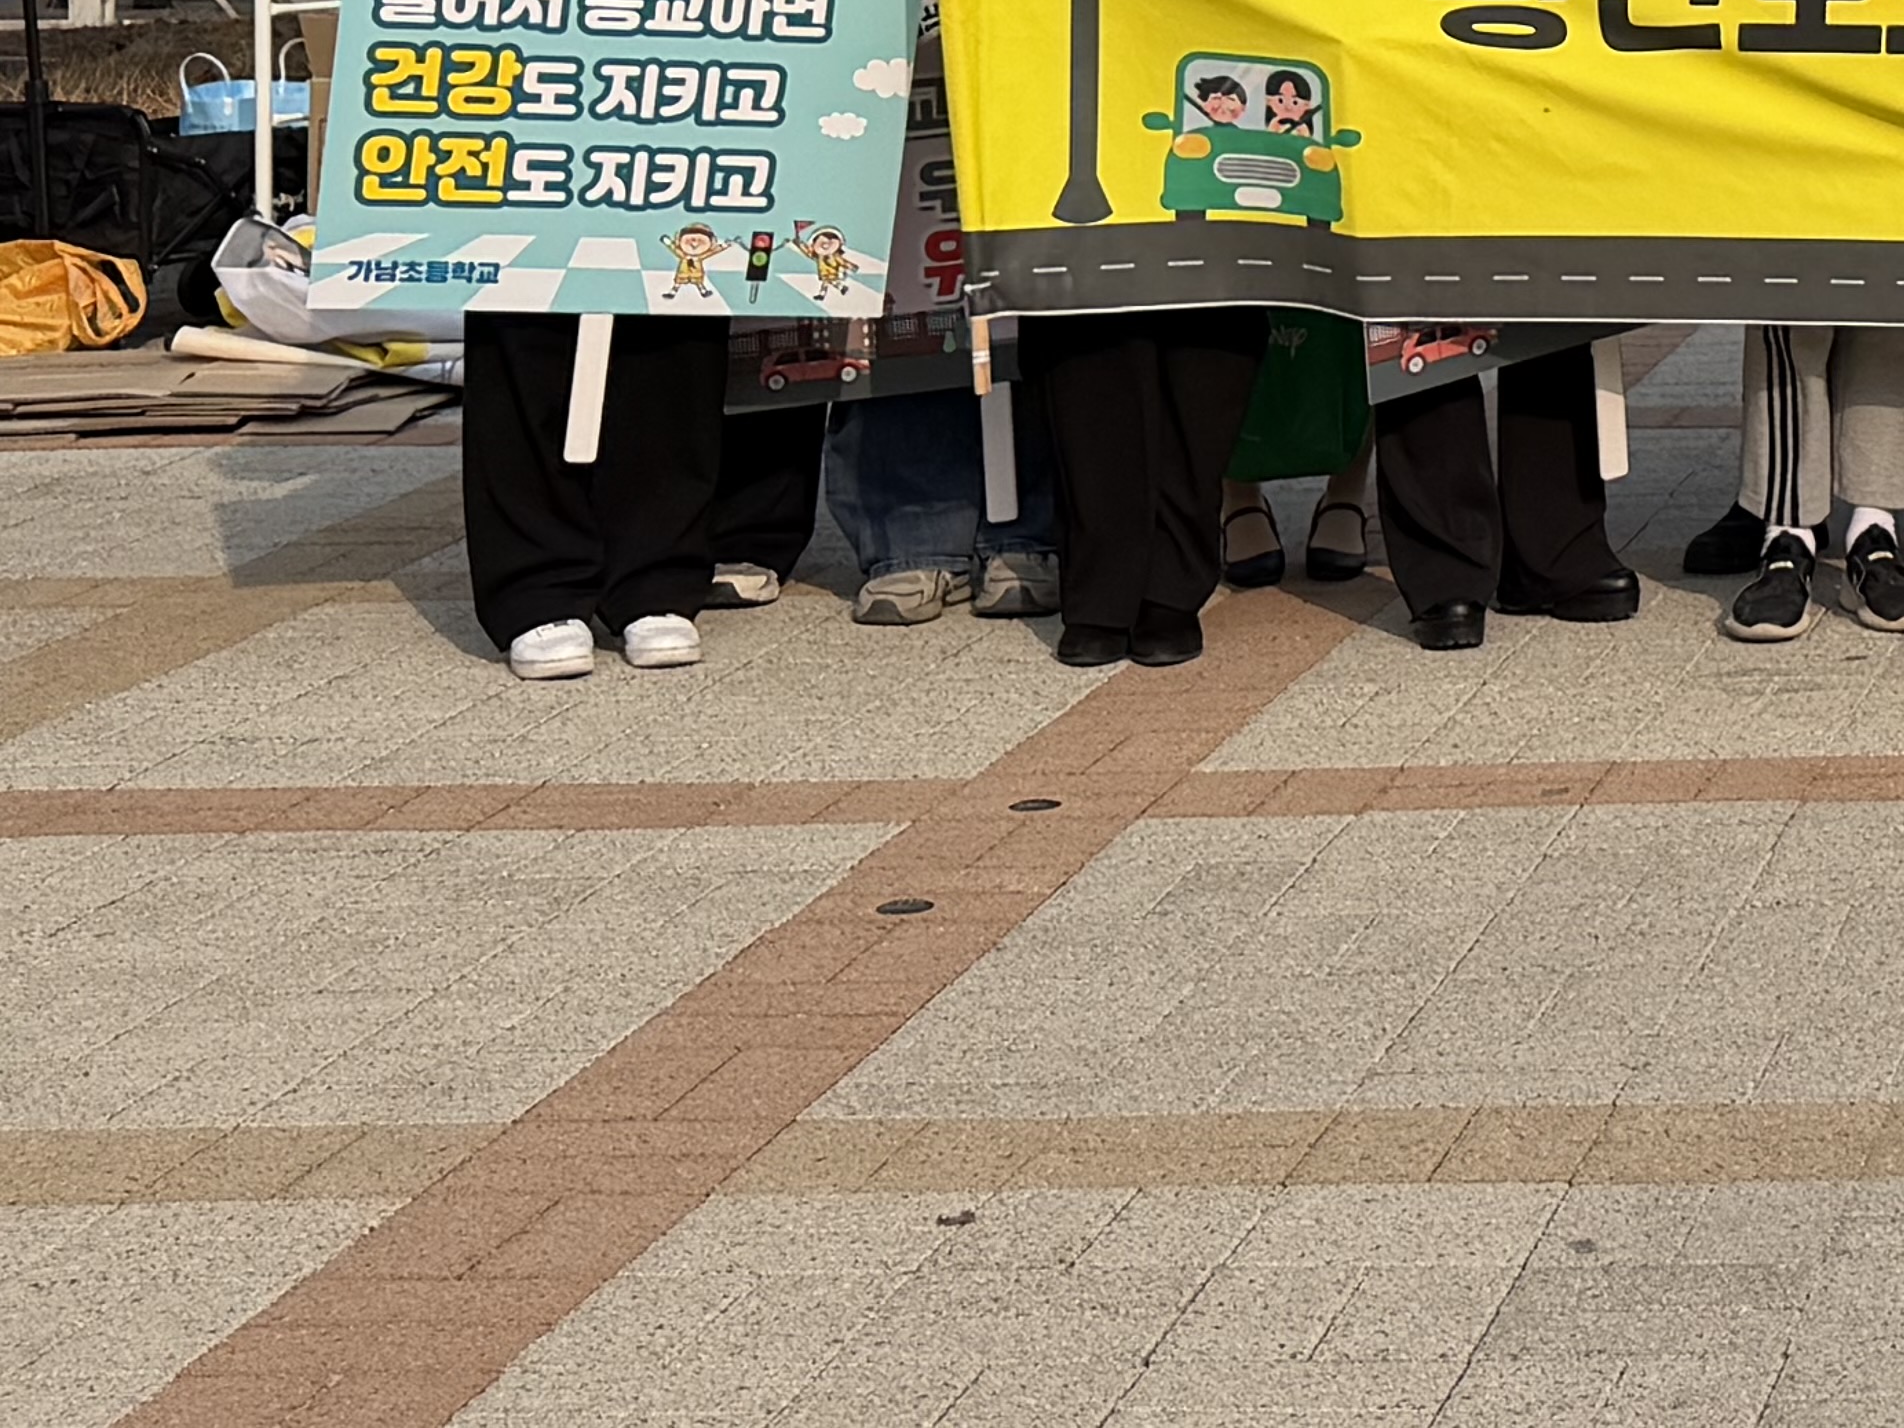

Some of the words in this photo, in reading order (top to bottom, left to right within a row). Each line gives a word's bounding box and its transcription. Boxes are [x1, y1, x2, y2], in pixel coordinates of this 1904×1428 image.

[369, 45, 579, 116] 건강도
[595, 62, 783, 122] 지키고
[360, 134, 568, 205] 안전도
[583, 149, 772, 209] 지키고
[347, 258, 501, 285] 가남초등학교
